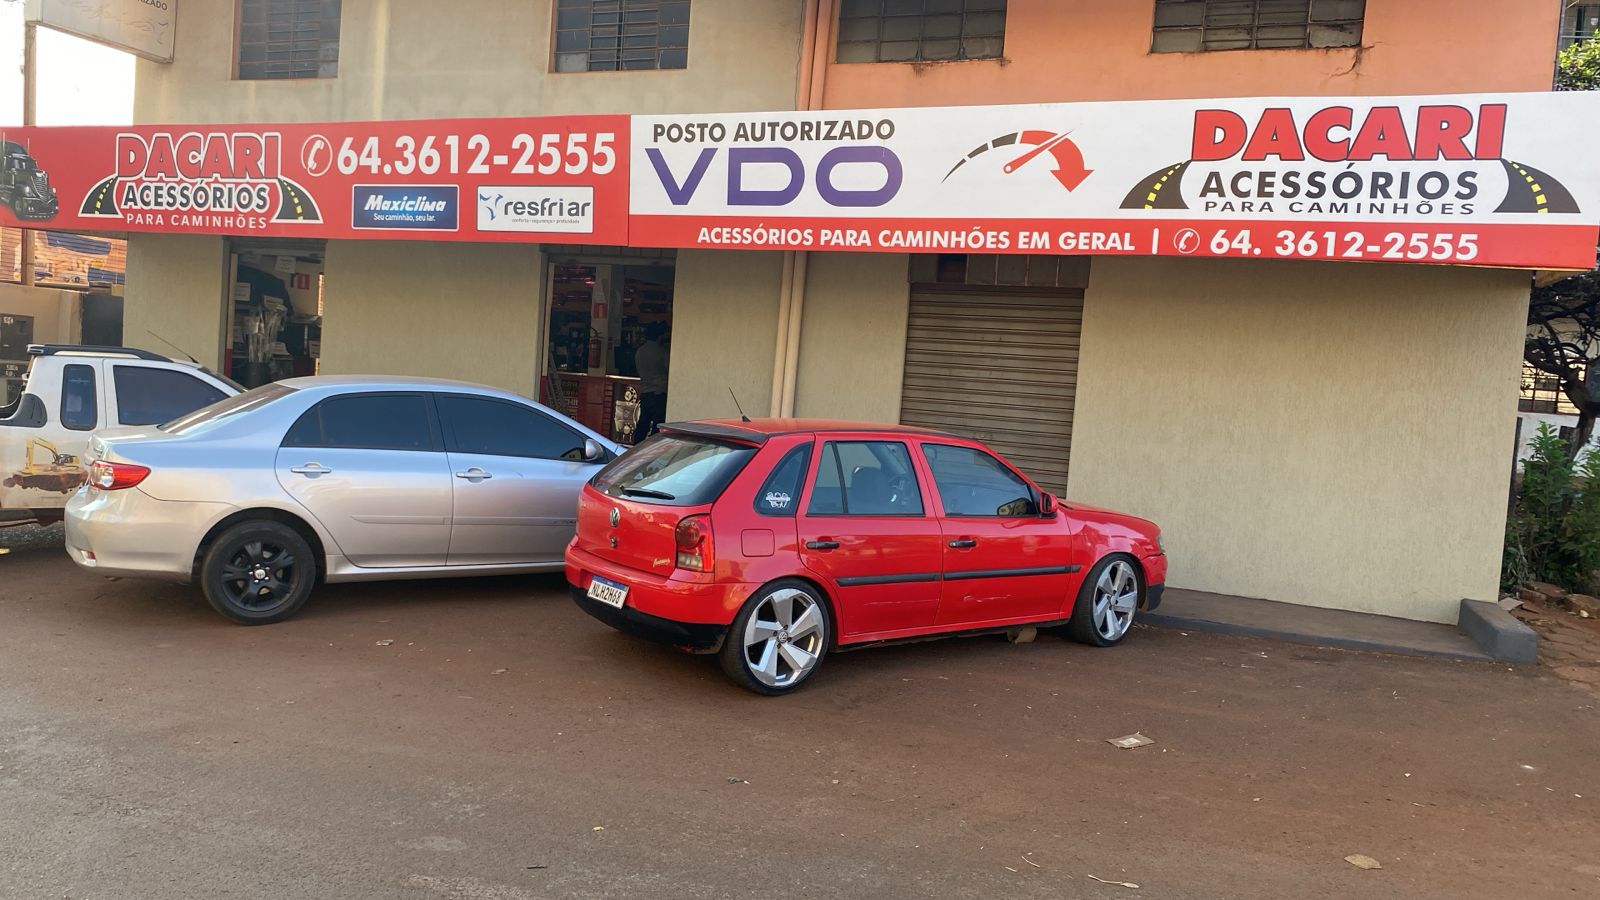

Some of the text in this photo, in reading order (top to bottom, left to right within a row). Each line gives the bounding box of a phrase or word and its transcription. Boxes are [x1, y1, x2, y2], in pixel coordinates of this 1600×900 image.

[653, 118, 896, 143] POSTO AUTORIZADO
[1190, 103, 1508, 162] DACARI
[116, 131, 281, 180] DACARI
[337, 132, 617, 175] 64.3612-2555
[644, 145, 903, 207] VDO
[1199, 163, 1479, 200] ACESSÓRIOS
[121, 180, 270, 211] ACESSÓRIOS
[1204, 200, 1475, 216] PARA CAMINHÕES
[126, 213, 267, 229] PARA CAMINHÕES
[373, 212, 385, 221] Seu
[385, 213, 415, 223] caminhão,
[415, 214, 425, 222] seu
[697, 224, 814, 246] ACESSÓRIOS
[819, 229, 872, 247] PARA
[877, 226, 1011, 249] CAMINHÕES
[1017, 231, 1050, 250] EM
[1058, 231, 1136, 251] GERAL
[1209, 229, 1262, 255] 64.
[1275, 229, 1479, 260] 3612-2555
